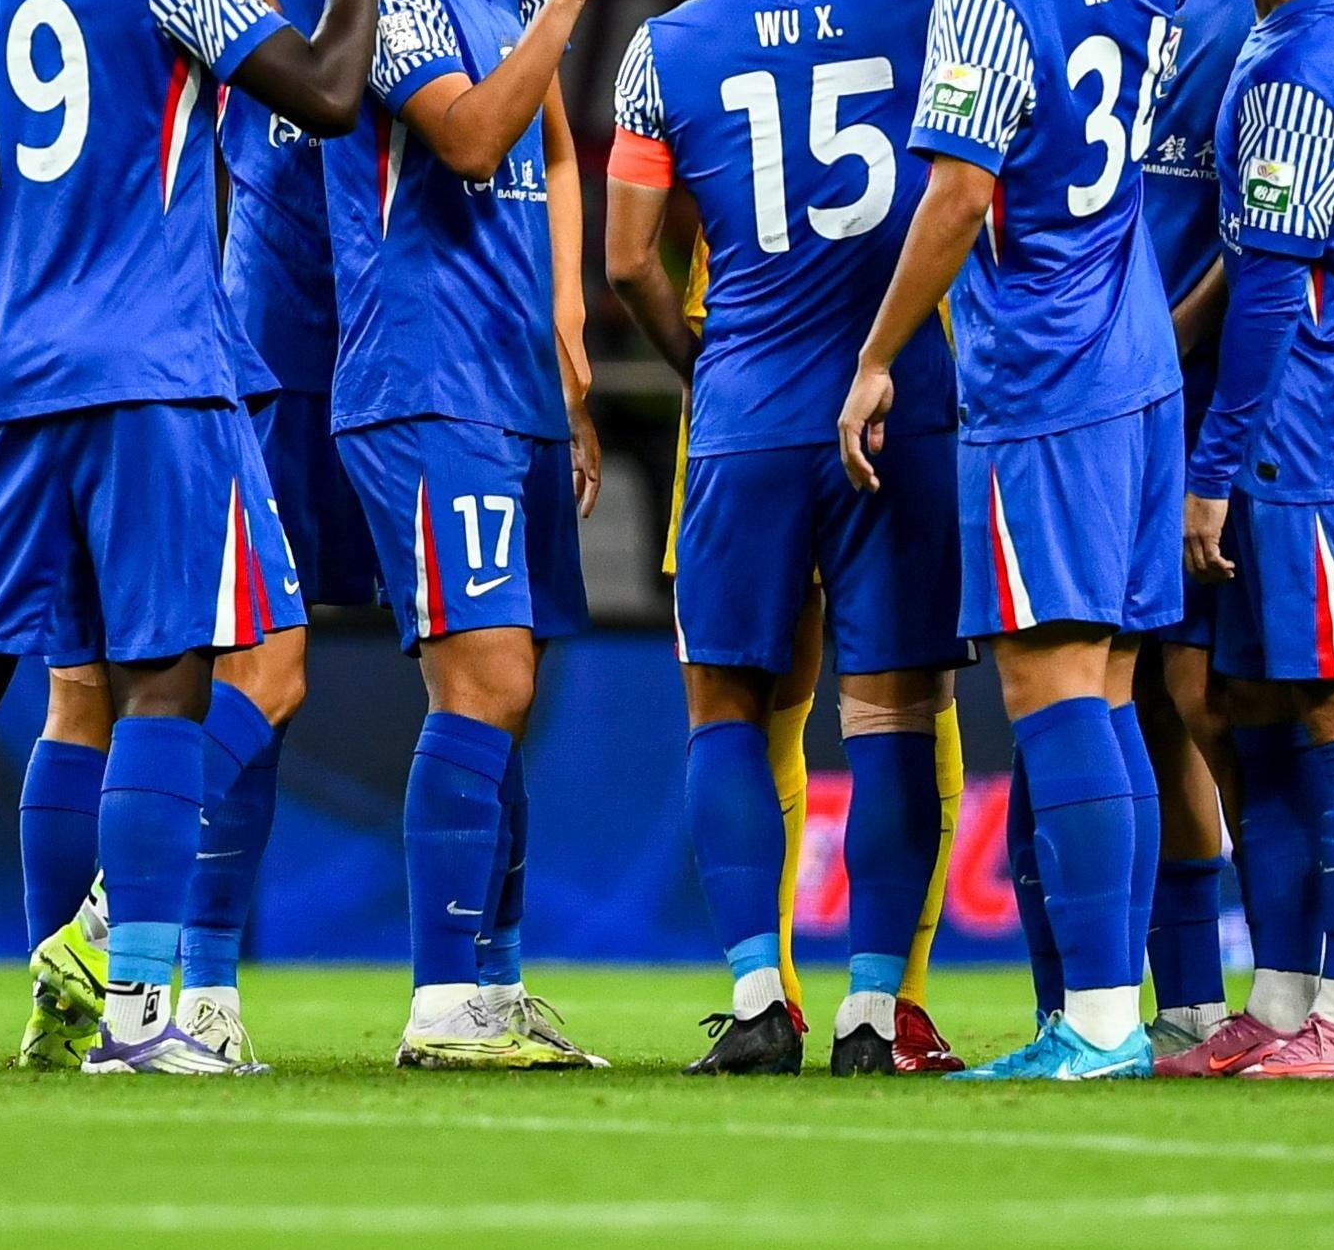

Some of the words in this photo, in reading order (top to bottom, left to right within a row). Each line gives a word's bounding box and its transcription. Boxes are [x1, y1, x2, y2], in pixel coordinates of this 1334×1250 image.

[754, 8, 800, 47] WU
[814, 4, 843, 40] X.
[720, 56, 896, 253] 15
[453, 495, 515, 569] 17
